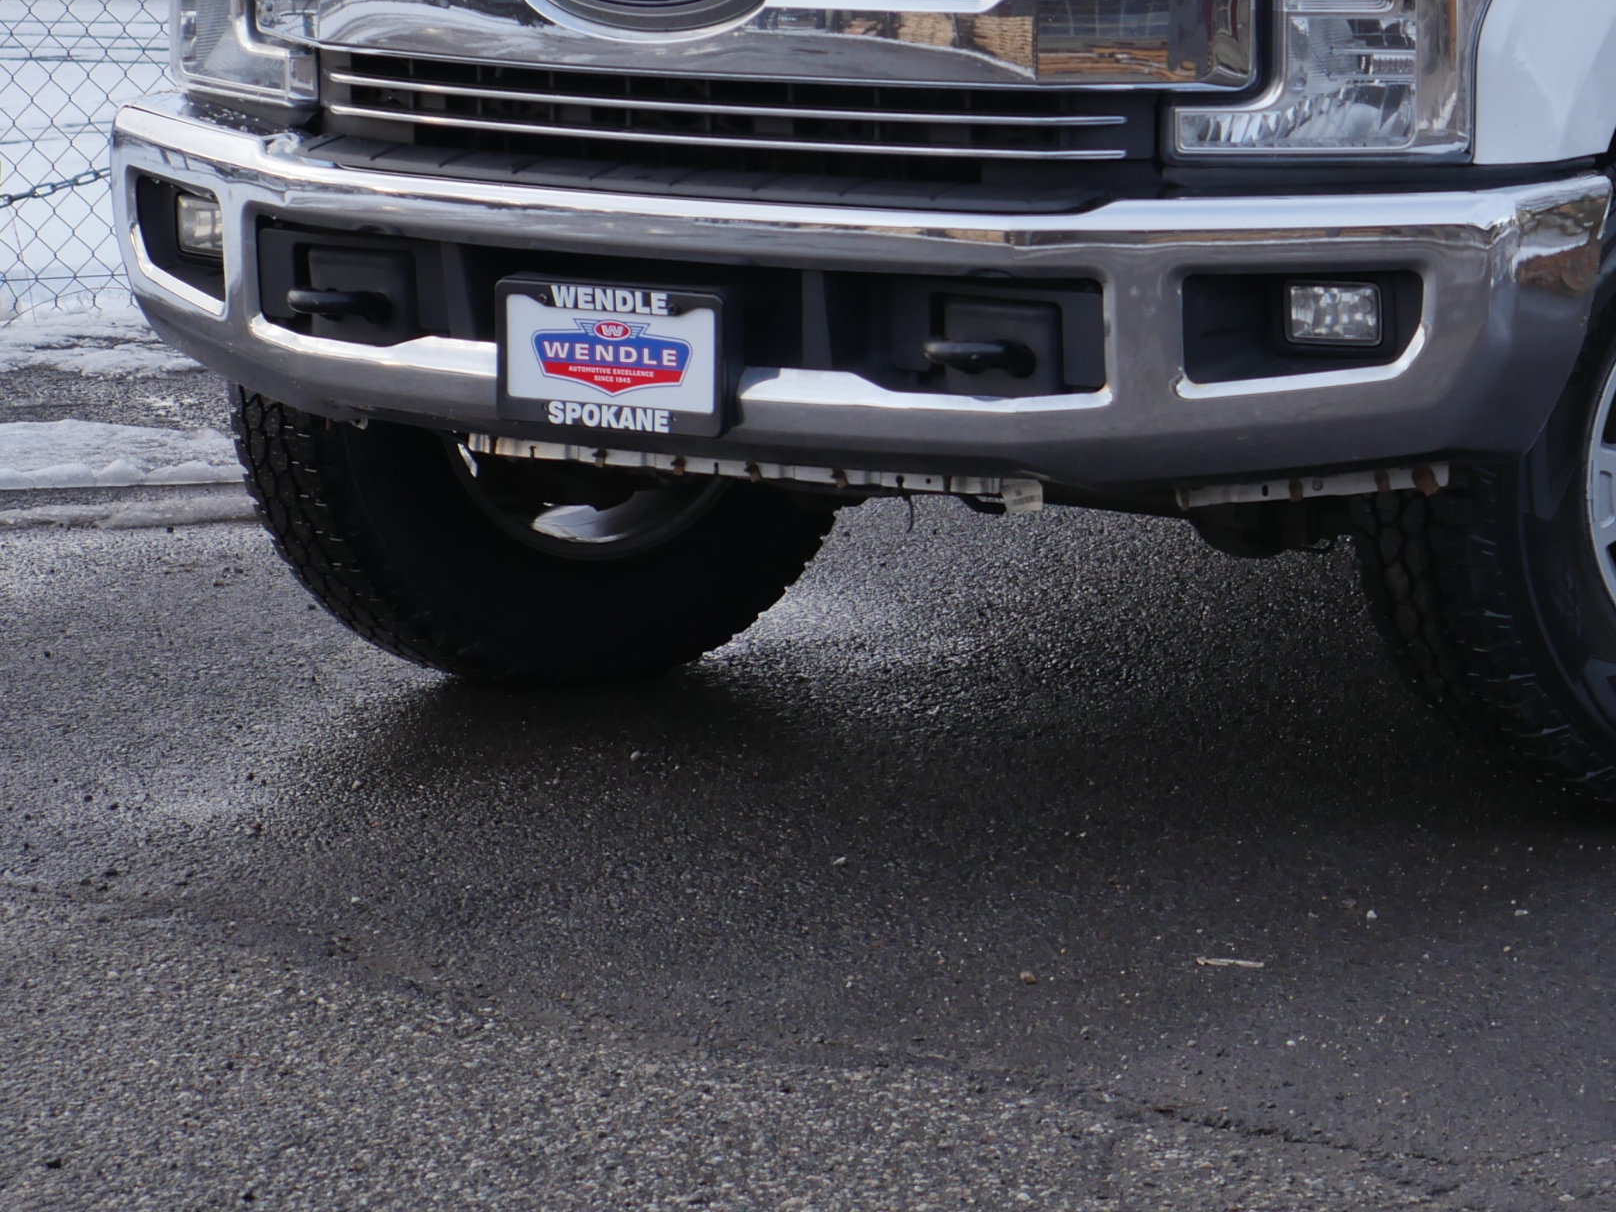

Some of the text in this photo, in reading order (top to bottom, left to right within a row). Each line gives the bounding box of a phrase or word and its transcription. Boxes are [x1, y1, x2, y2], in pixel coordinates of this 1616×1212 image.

[550, 284, 669, 317] WENDLE
[543, 340, 678, 366] WENDLE
[568, 365, 655, 378] AUTOMOTIVE EXCELLENCE
[593, 374, 614, 383] SINCE
[548, 400, 670, 434] SPOKANE
